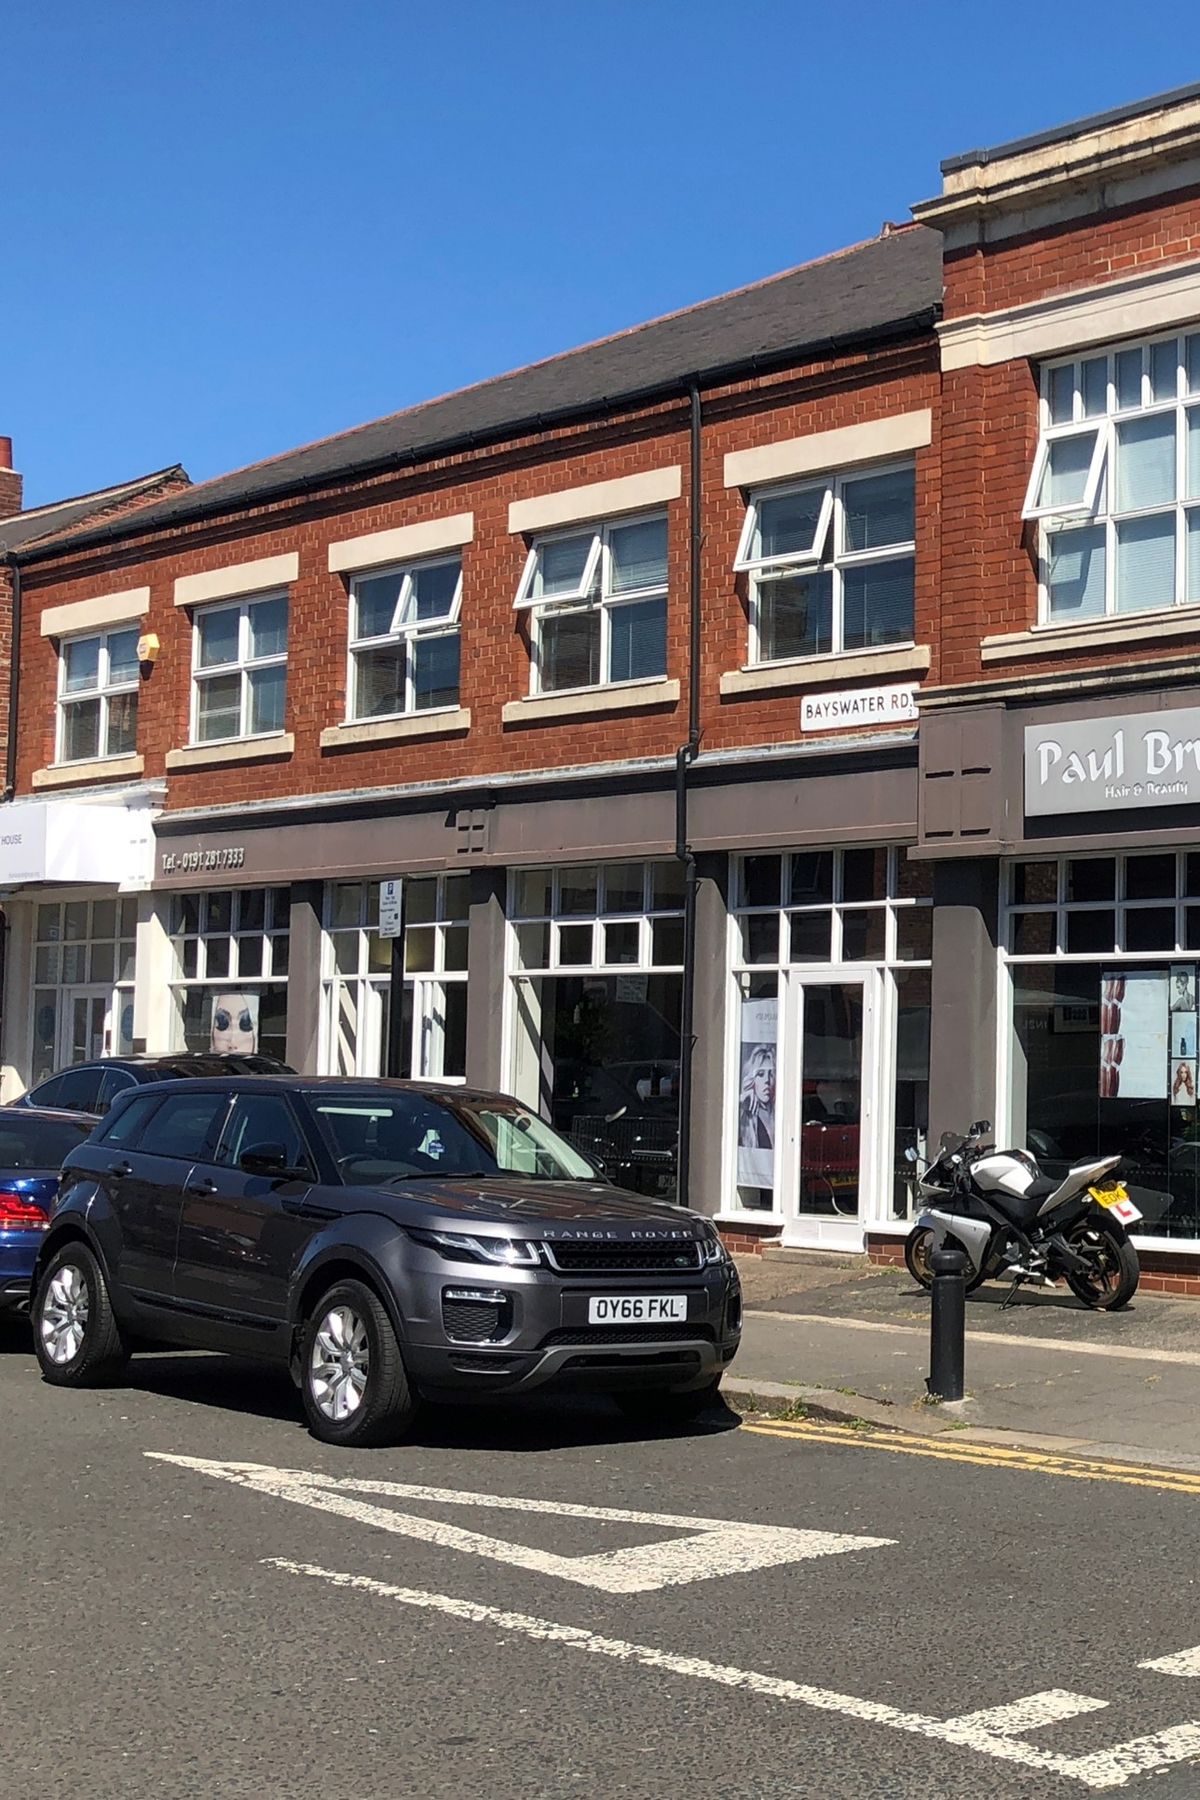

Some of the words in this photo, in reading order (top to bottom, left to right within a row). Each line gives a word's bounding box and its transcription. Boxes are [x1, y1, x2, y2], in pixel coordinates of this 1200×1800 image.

[806, 696, 885, 719] BAYSWATER
[908, 709, 913, 717] 2
[1036, 728, 1125, 785] Paul
[1105, 783, 1131, 799] Hair
[1133, 783, 1143, 797] &
[1146, 780, 1189, 796] Beauty
[1, 834, 22, 845] HOUSE
[162, 853, 176, 870] Tel
[182, 852, 204, 868] 0191
[205, 850, 222, 866] 281
[223, 847, 245, 866] 7333
[1115, 1204, 1133, 1218] L
[543, 1230, 618, 1240] RANGE
[631, 1230, 693, 1239] ROVER
[597, 1299, 643, 1319] OY66
[648, 1298, 679, 1318] FKL
